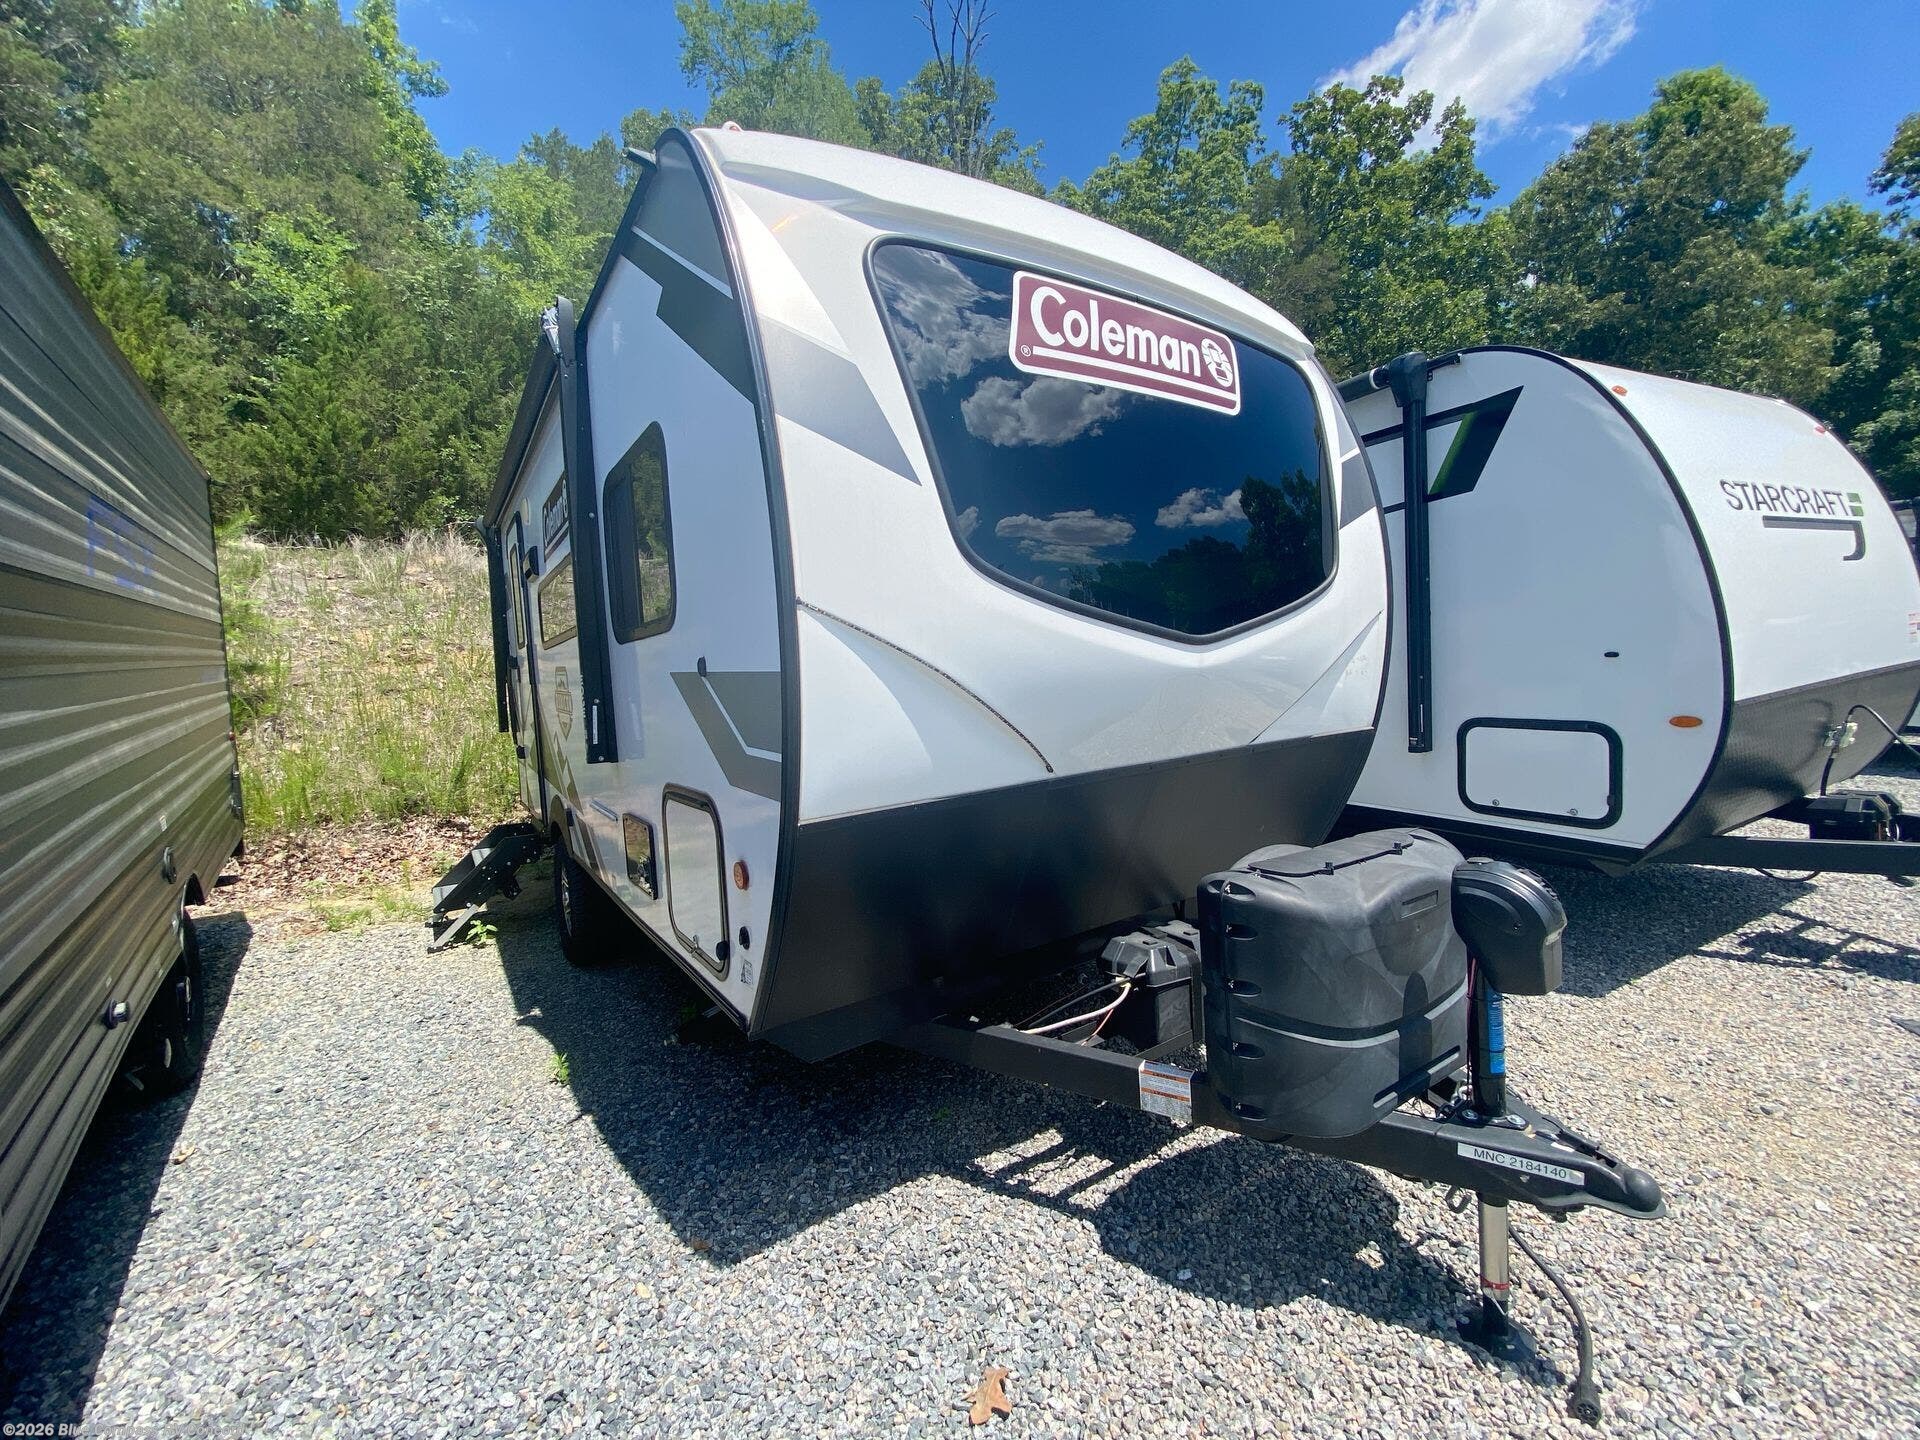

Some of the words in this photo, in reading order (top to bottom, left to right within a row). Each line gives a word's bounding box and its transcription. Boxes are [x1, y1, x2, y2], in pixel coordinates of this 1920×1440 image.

[1030, 286, 1202, 378] Coleman
[1719, 479, 1849, 517] STARCRAFT
[1473, 1148, 1505, 1164] MNC
[1509, 1157, 1567, 1179] 2184140
